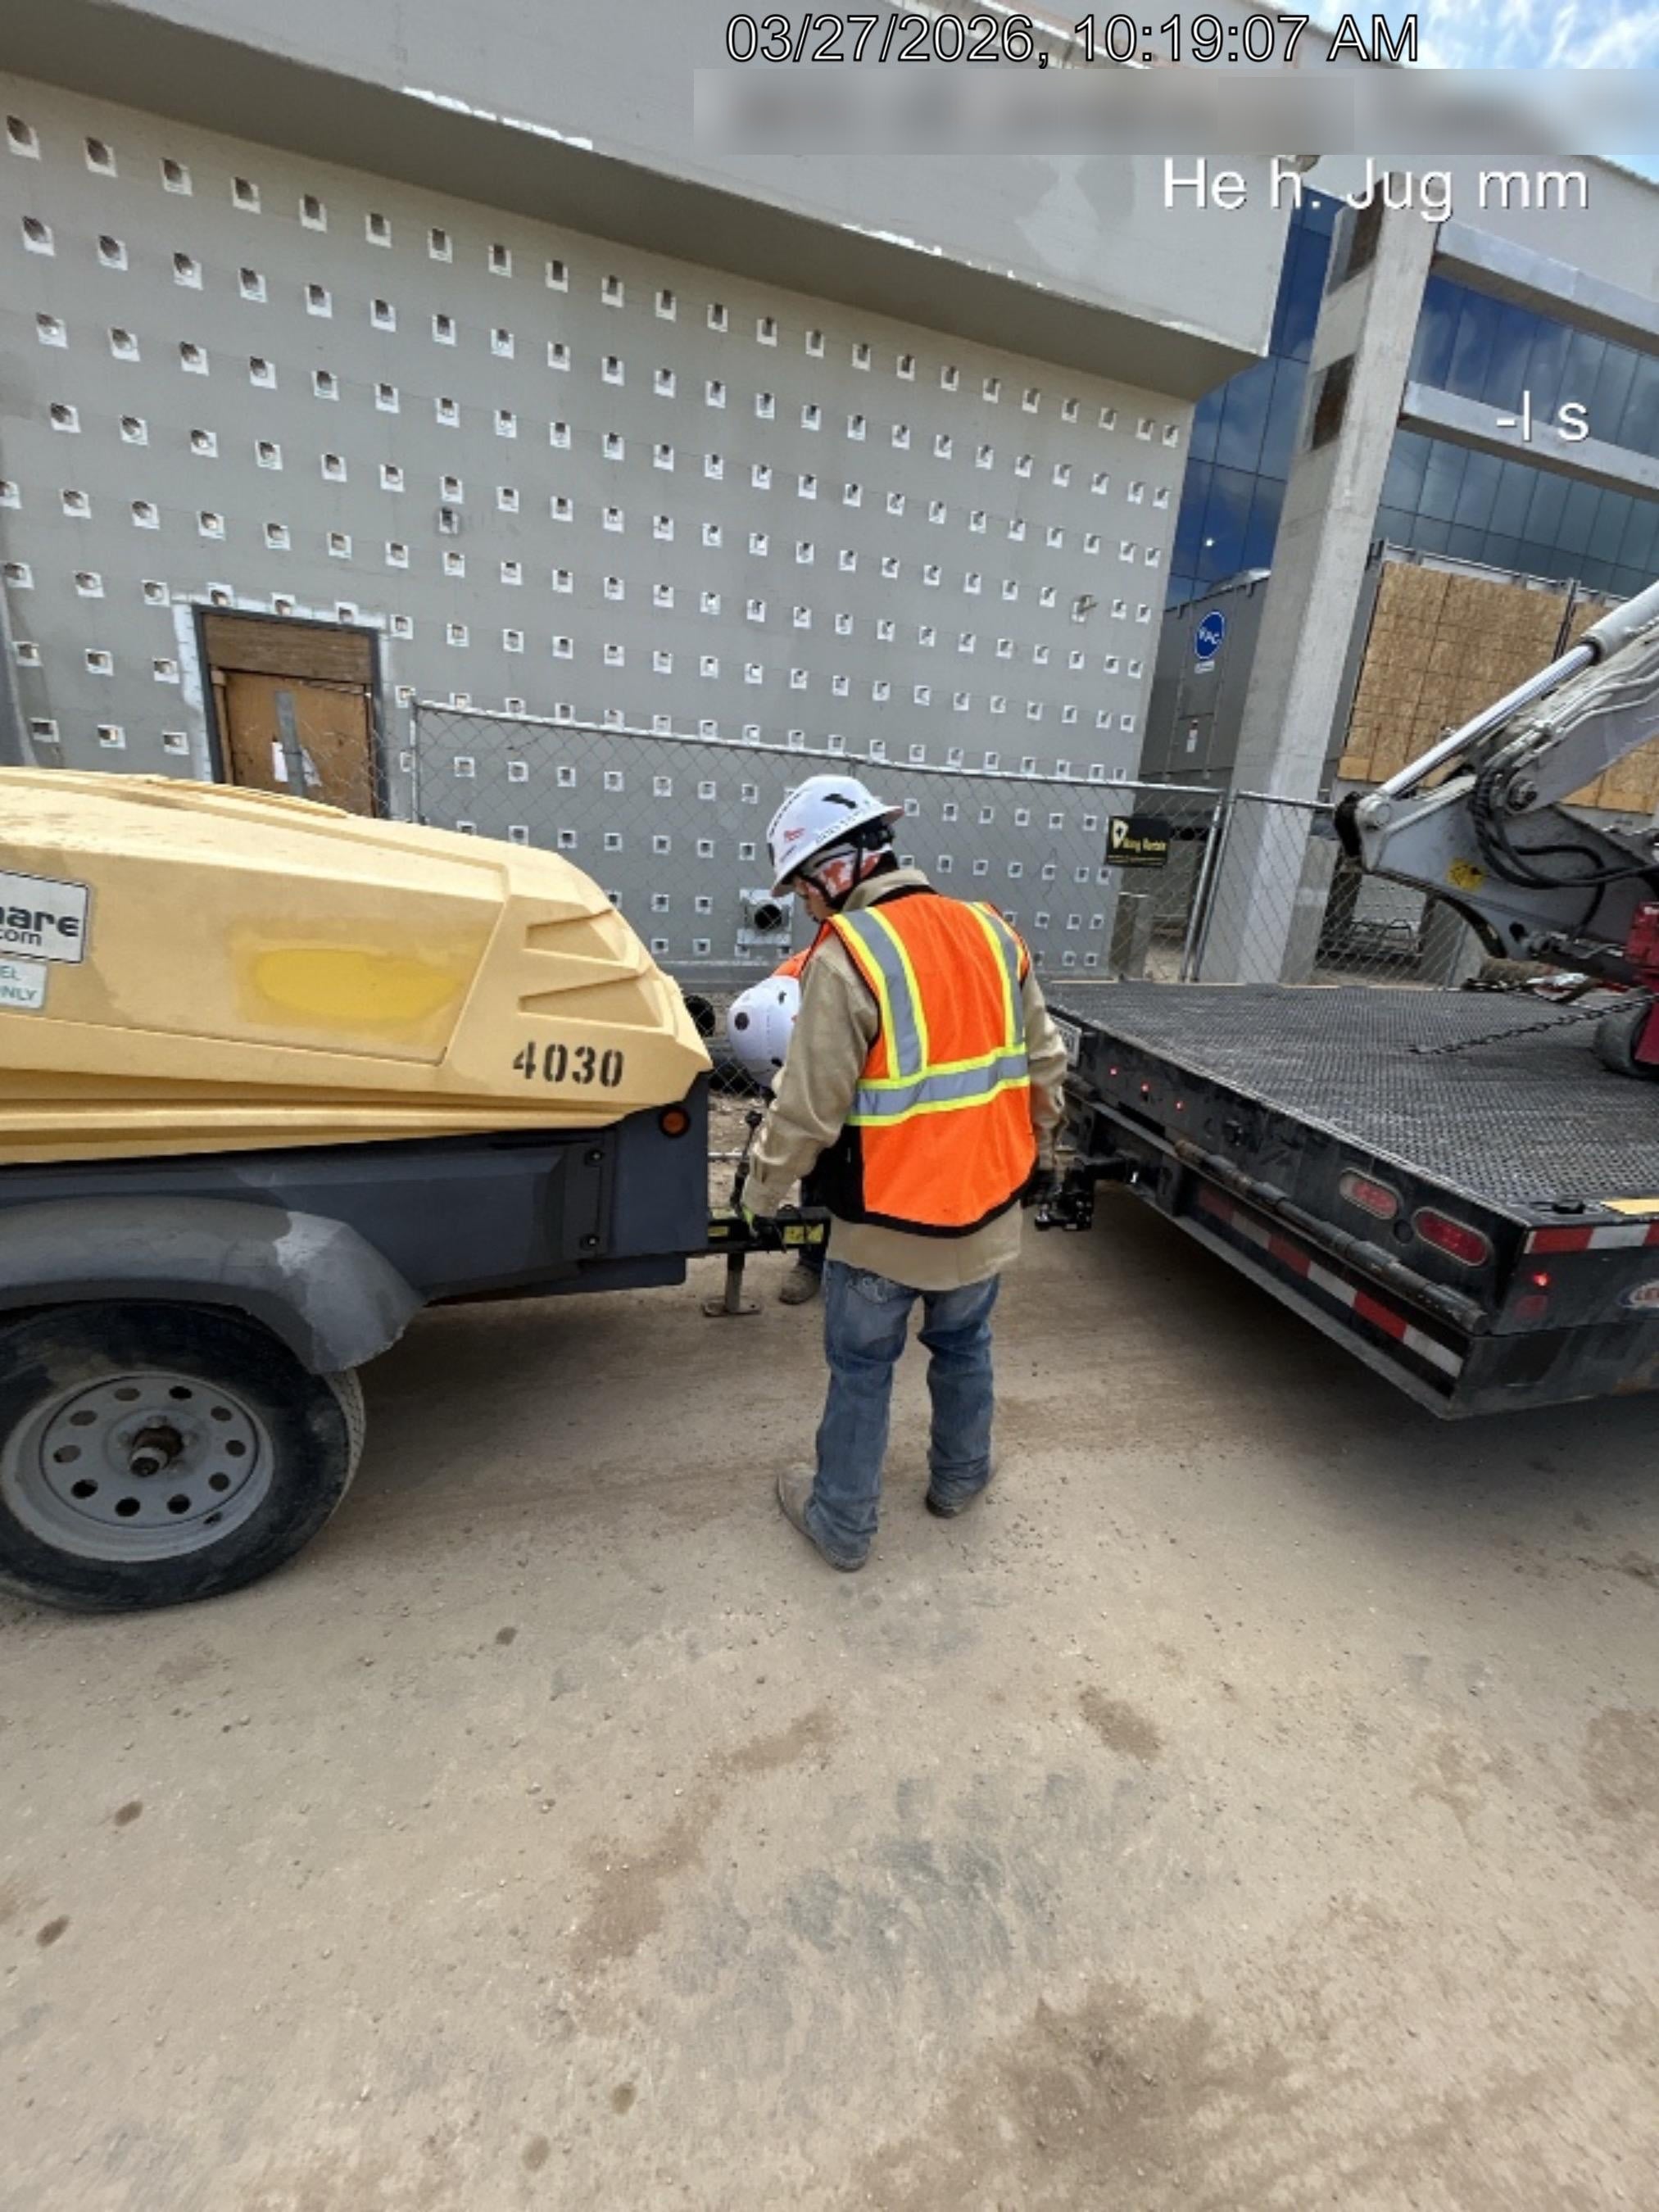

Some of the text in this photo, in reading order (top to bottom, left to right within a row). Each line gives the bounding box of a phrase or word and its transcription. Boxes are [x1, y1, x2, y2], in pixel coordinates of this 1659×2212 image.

[0, 905, 79, 937] are
[0, 928, 42, 946] om
[0, 986, 37, 1001] NLY
[512, 1040, 623, 1088] 4030
